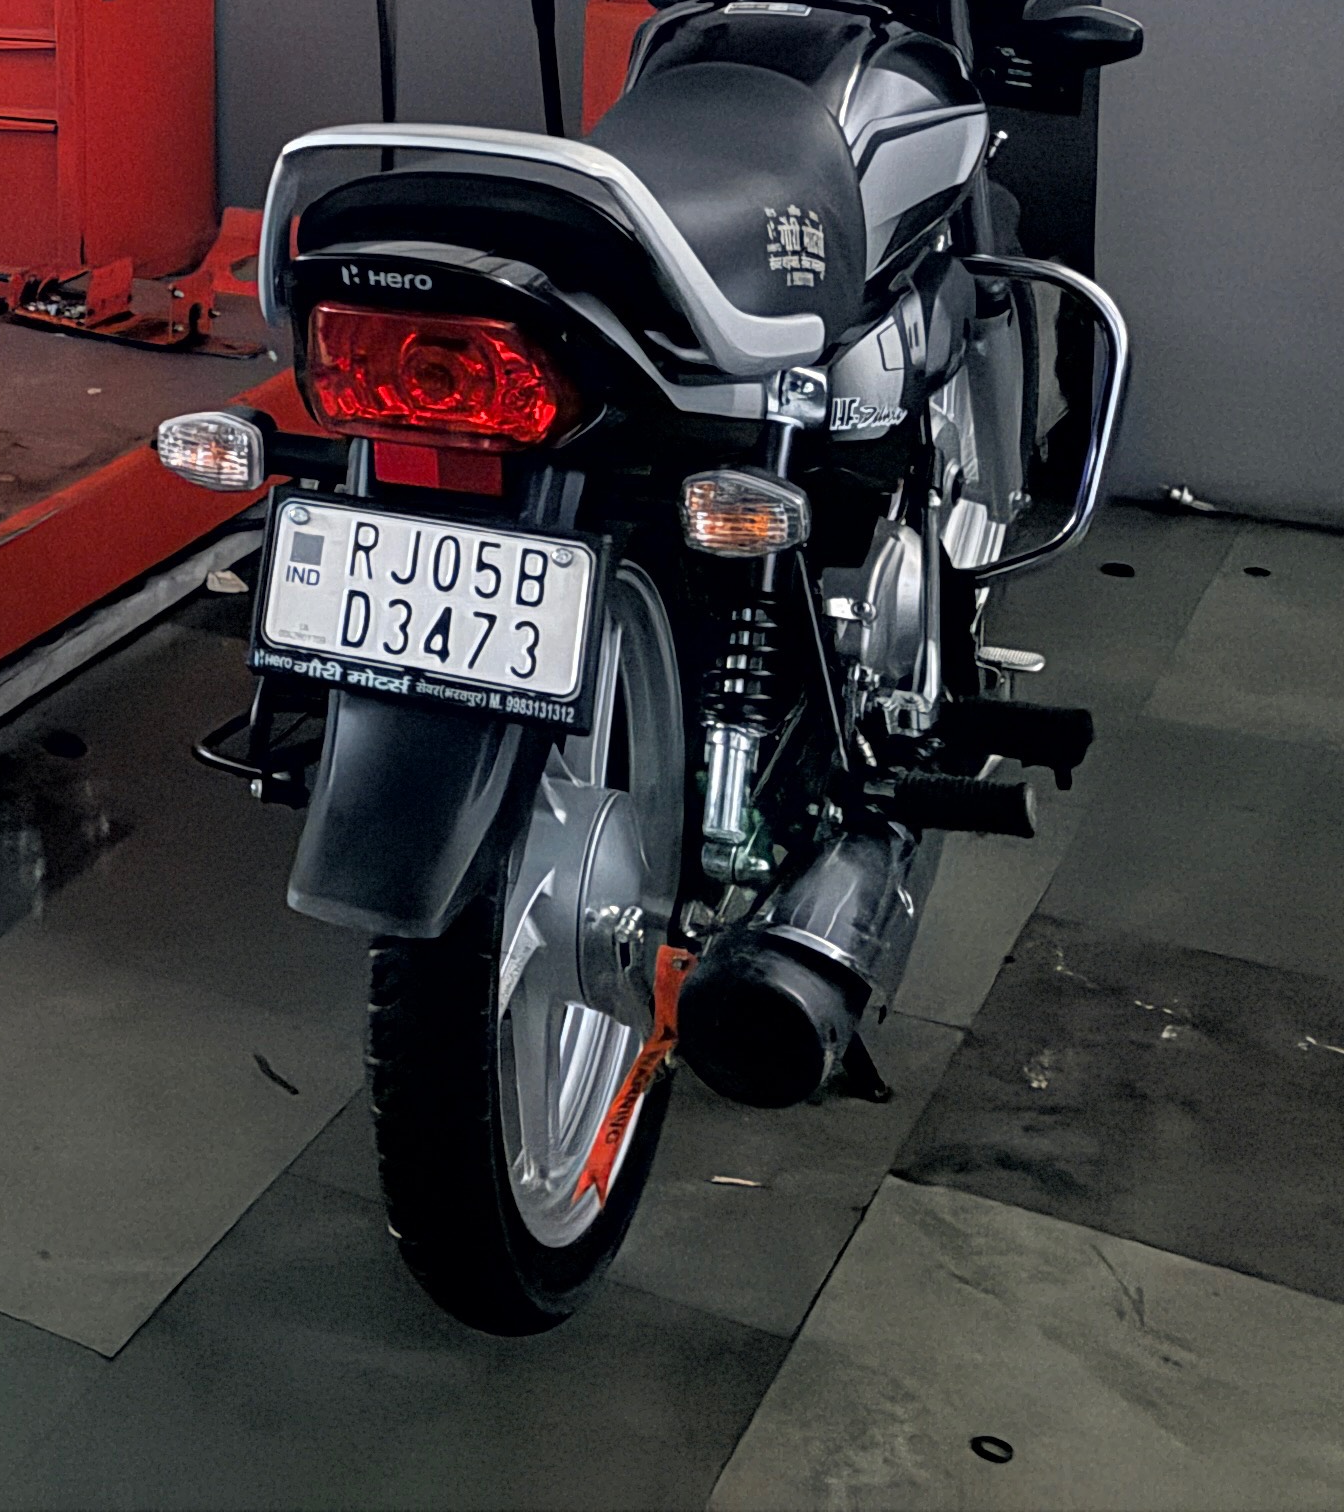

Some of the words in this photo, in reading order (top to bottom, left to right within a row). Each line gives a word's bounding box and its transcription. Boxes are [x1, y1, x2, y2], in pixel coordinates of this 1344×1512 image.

[368, 269, 433, 291] Hero
[285, 564, 321, 586] IND
[349, 521, 549, 608] RJ05B
[340, 589, 540, 680] D3473
[264, 653, 293, 670] Hero
[293, 657, 343, 682] गौरी
[346, 667, 413, 695] मोटर्स
[505, 696, 575, 724] 9983131312
